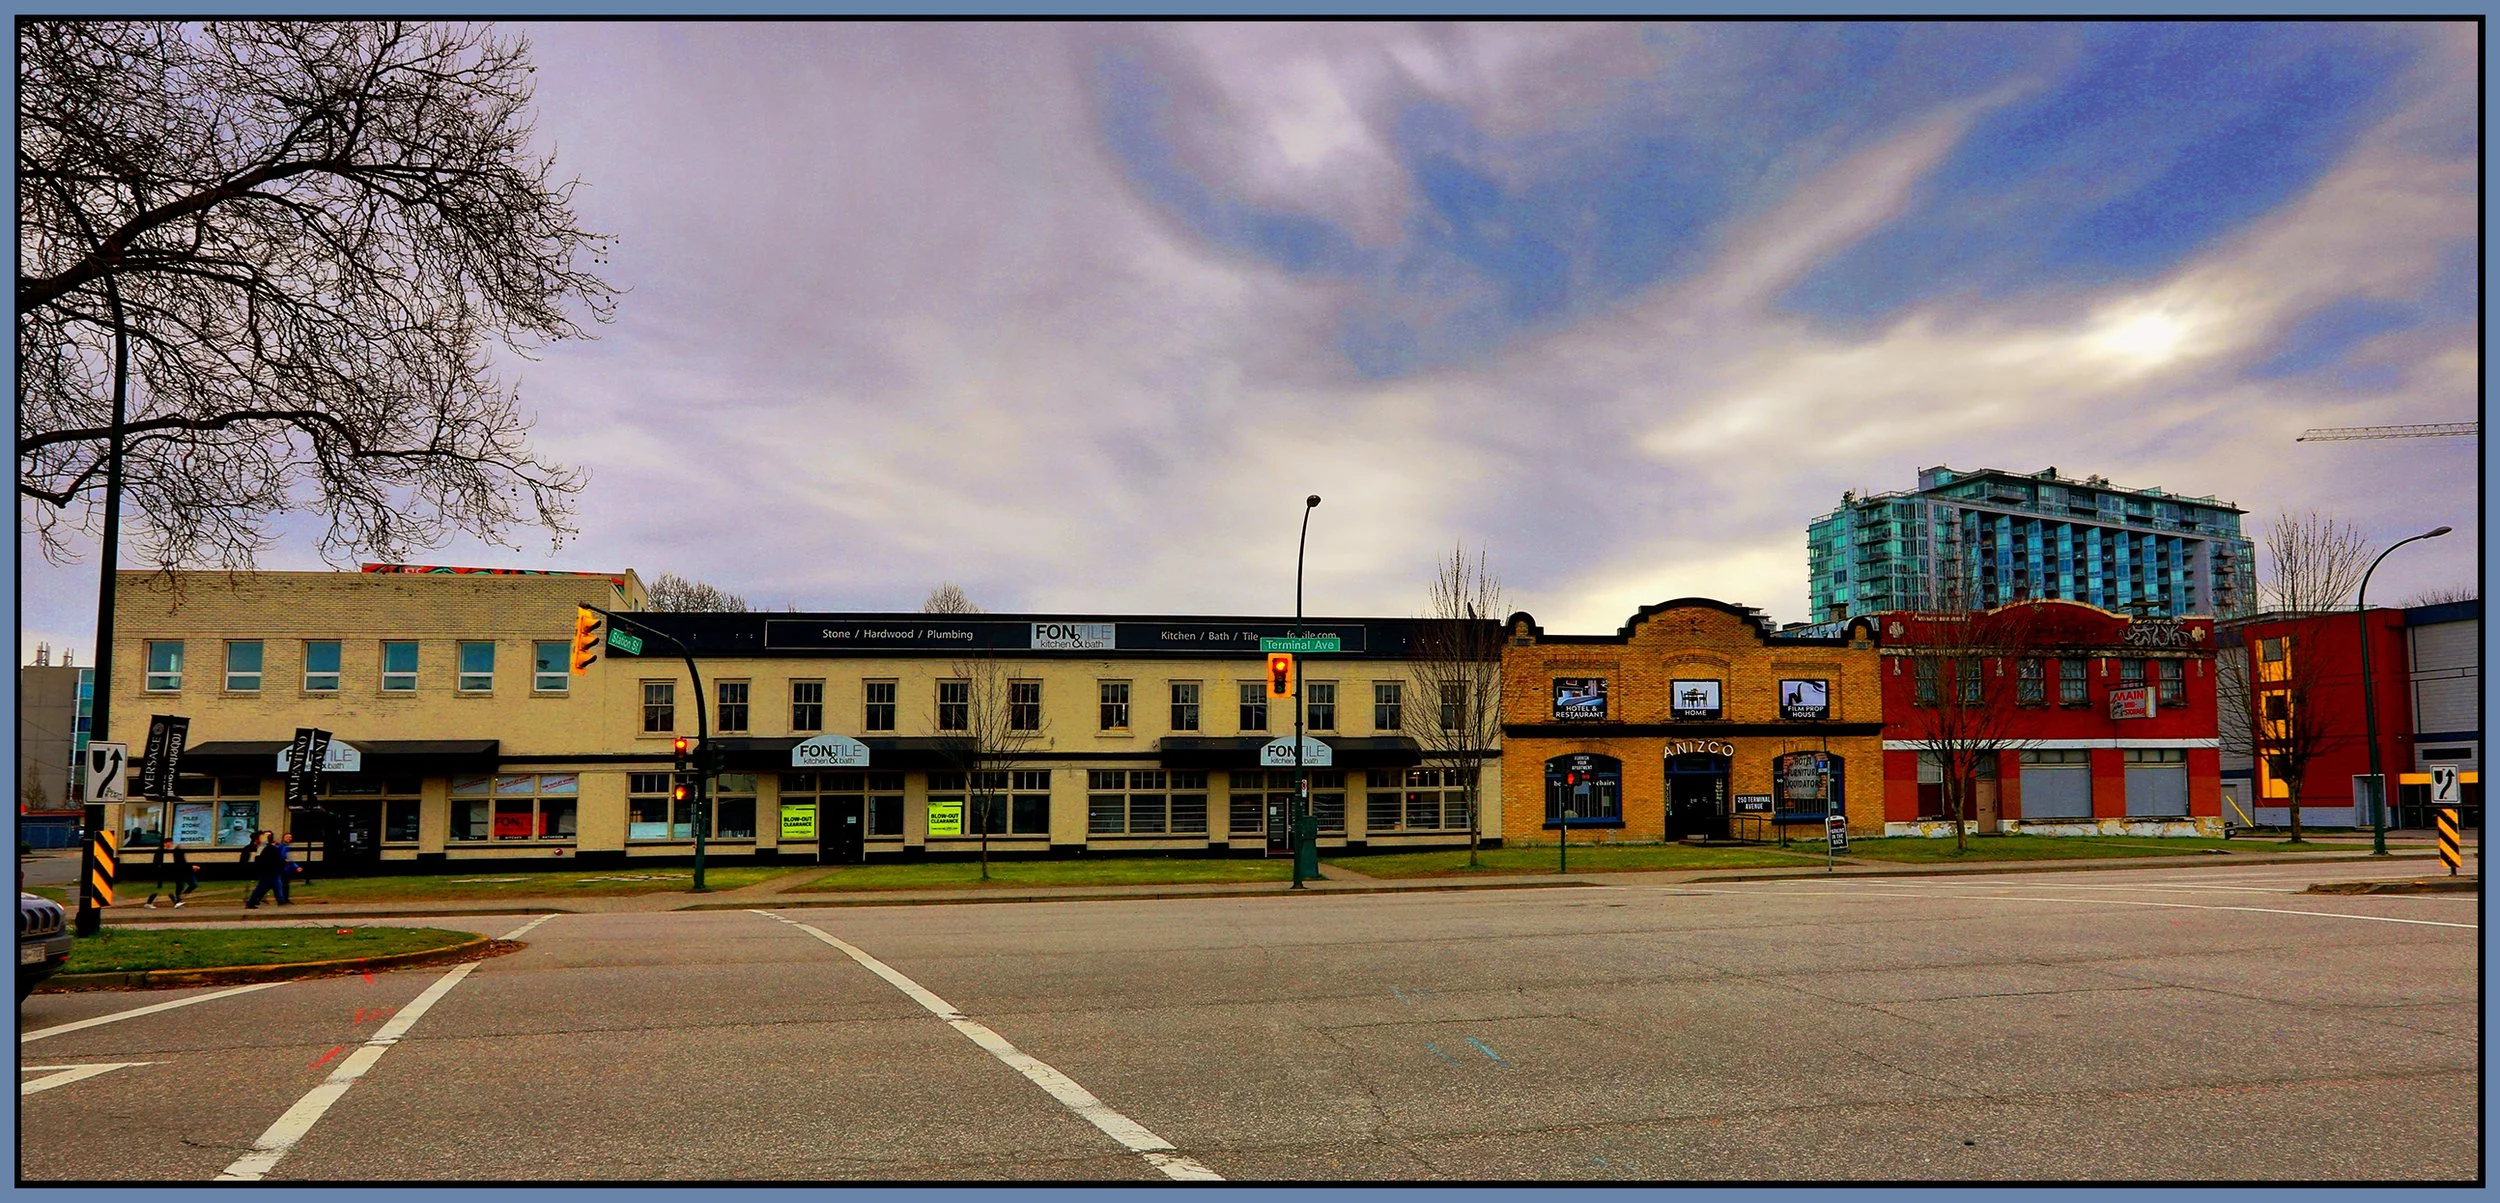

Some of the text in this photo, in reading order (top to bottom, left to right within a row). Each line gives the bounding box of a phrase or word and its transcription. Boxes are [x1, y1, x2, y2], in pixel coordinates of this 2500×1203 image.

[822, 628, 850, 639] Stone
[864, 629, 914, 639] Hardwood
[927, 629, 973, 641] Plumbing
[1036, 624, 1112, 640] FONTILE
[1161, 631, 1196, 640] Kitchen
[1208, 631, 1229, 640] Bath
[1242, 632, 1259, 641] Tile
[611, 632, 640, 652] Station St
[1040, 633, 1103, 648] kitchen & bath
[1266, 640, 1335, 650] Terminal Ave
[2110, 690, 2145, 702] MAIN
[800, 744, 862, 758] FONTILE
[1663, 740, 1734, 758] ANIZCO
[145, 736, 162, 790] VERSACE
[828, 752, 838, 764] &
[288, 735, 308, 800] VALENTINO
